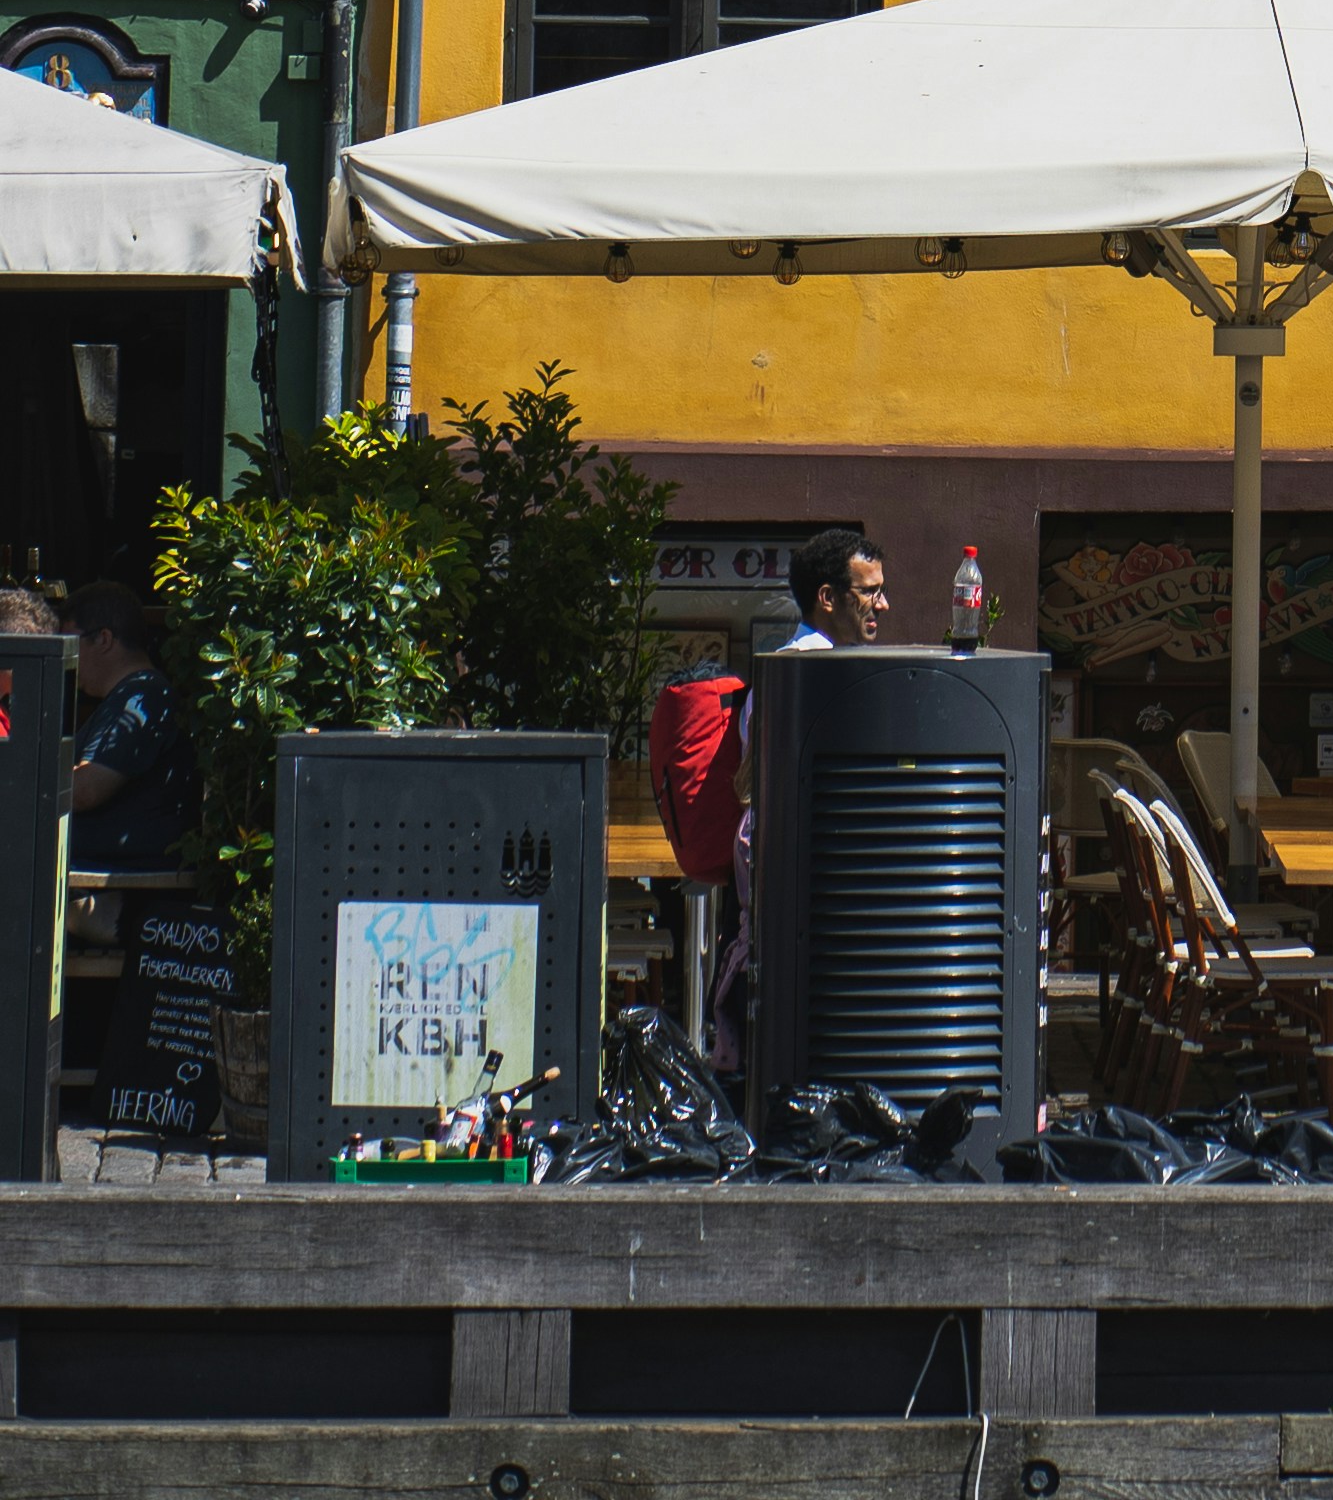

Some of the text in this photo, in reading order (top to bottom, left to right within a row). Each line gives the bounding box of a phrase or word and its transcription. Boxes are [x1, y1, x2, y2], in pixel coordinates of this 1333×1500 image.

[1064, 578, 1181, 636] TATTOO
[1190, 596, 1318, 658] NYAVN
[379, 961, 489, 1001] REN
[378, 1017, 488, 1057] KBH
[108, 1086, 195, 1133] HEERING
